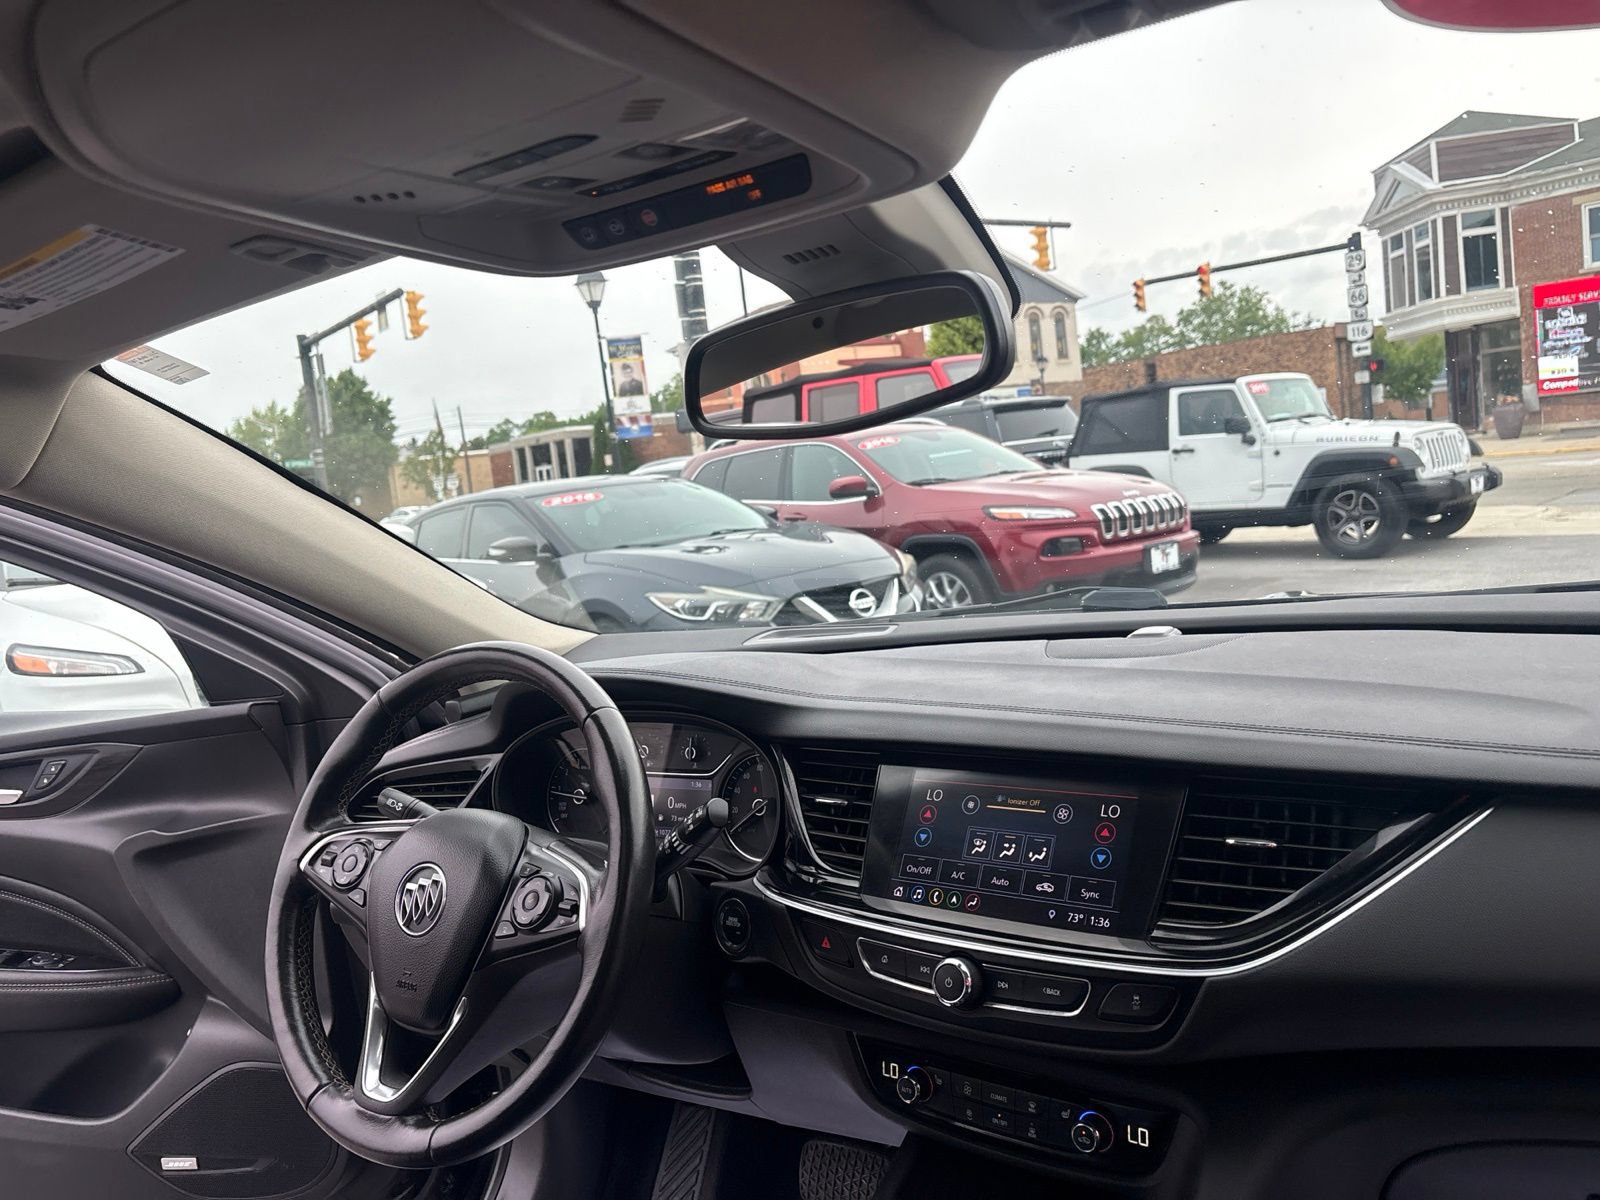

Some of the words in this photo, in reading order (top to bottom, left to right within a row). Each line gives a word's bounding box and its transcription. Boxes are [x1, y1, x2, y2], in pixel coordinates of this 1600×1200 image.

[1347, 253, 1363, 268] 29
[1350, 290, 1365, 302] 66
[1351, 326, 1369, 338] 116
[1315, 434, 1379, 443] RUBICON
[926, 789, 944, 802] LO
[1007, 797, 1028, 807] Ionizer
[1029, 799, 1041, 807] Off
[667, 796, 675, 809] 0
[1100, 804, 1121, 819] LO
[906, 864, 933, 876] On/Off
[950, 870, 966, 881] A/C
[990, 876, 1010, 887] Auto
[1080, 888, 1101, 901] Sync
[1089, 915, 1111, 928] 1:36
[881, 1060, 899, 1080] LO
[1127, 1123, 1150, 1148] LO
